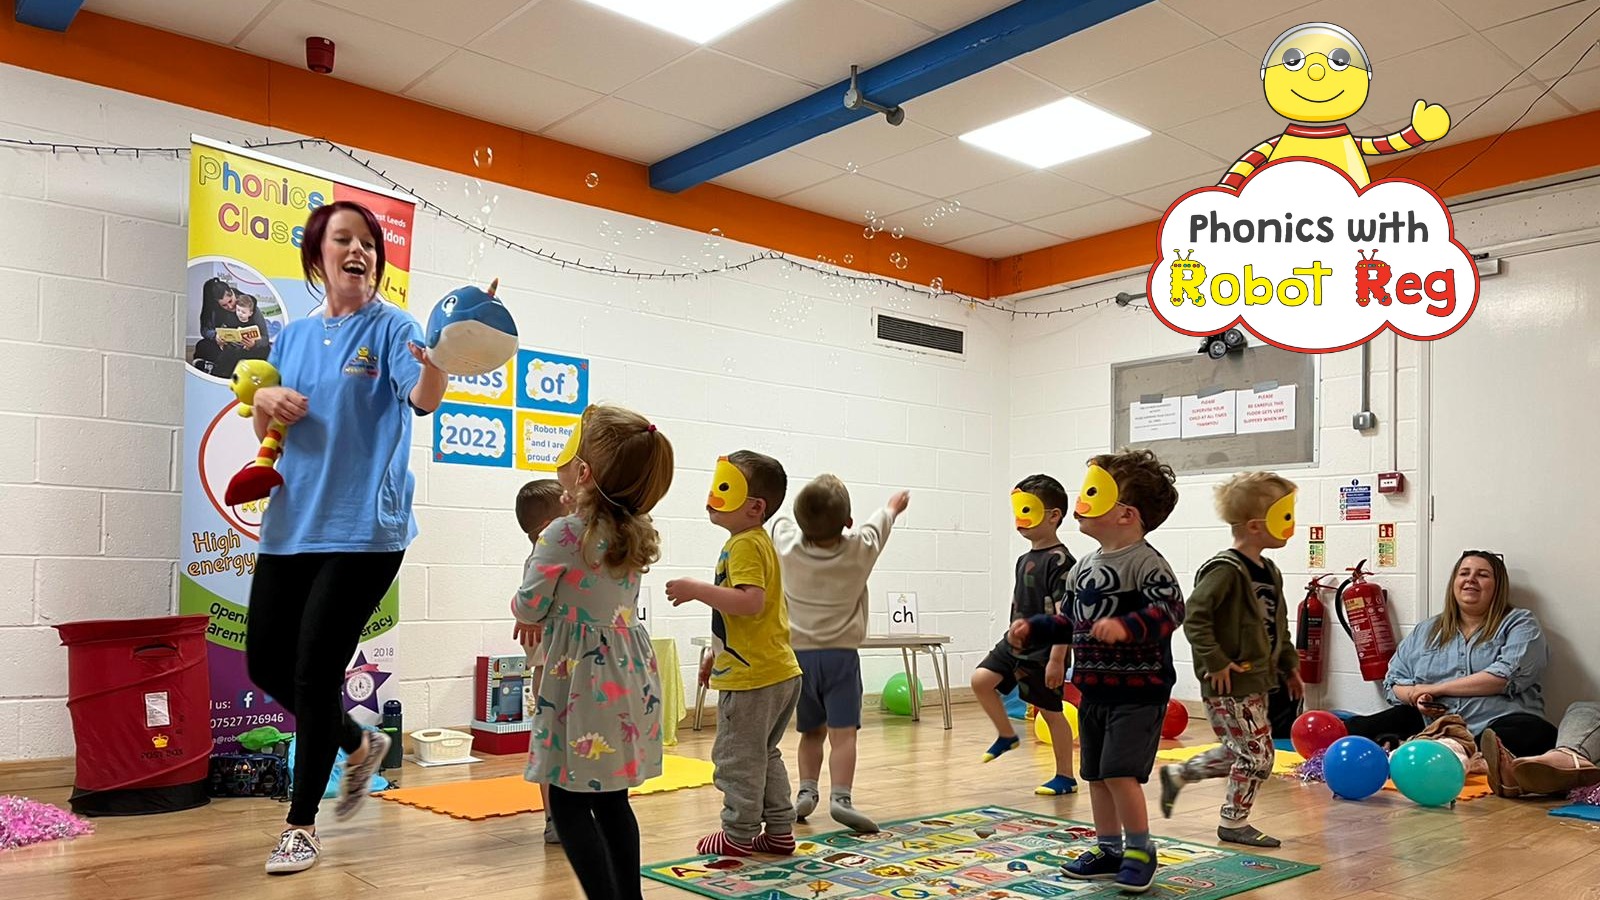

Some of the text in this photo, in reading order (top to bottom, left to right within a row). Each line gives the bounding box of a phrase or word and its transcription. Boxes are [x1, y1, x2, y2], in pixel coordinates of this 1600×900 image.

[199, 155, 324, 211] Phonics
[218, 202, 304, 248] Class
[386, 214, 407, 228] Leeds
[540, 372, 566, 396] of
[445, 425, 497, 449] 2022
[533, 424, 557, 435] Robot
[531, 439, 546, 447] and
[527, 454, 550, 462] proud
[192, 528, 241, 557] High
[187, 552, 256, 577] energy
[892, 605, 914, 623] ch
[373, 647, 394, 657] 2018
[215, 700, 231, 710] us:
[209, 712, 284, 729] 07527 726946
